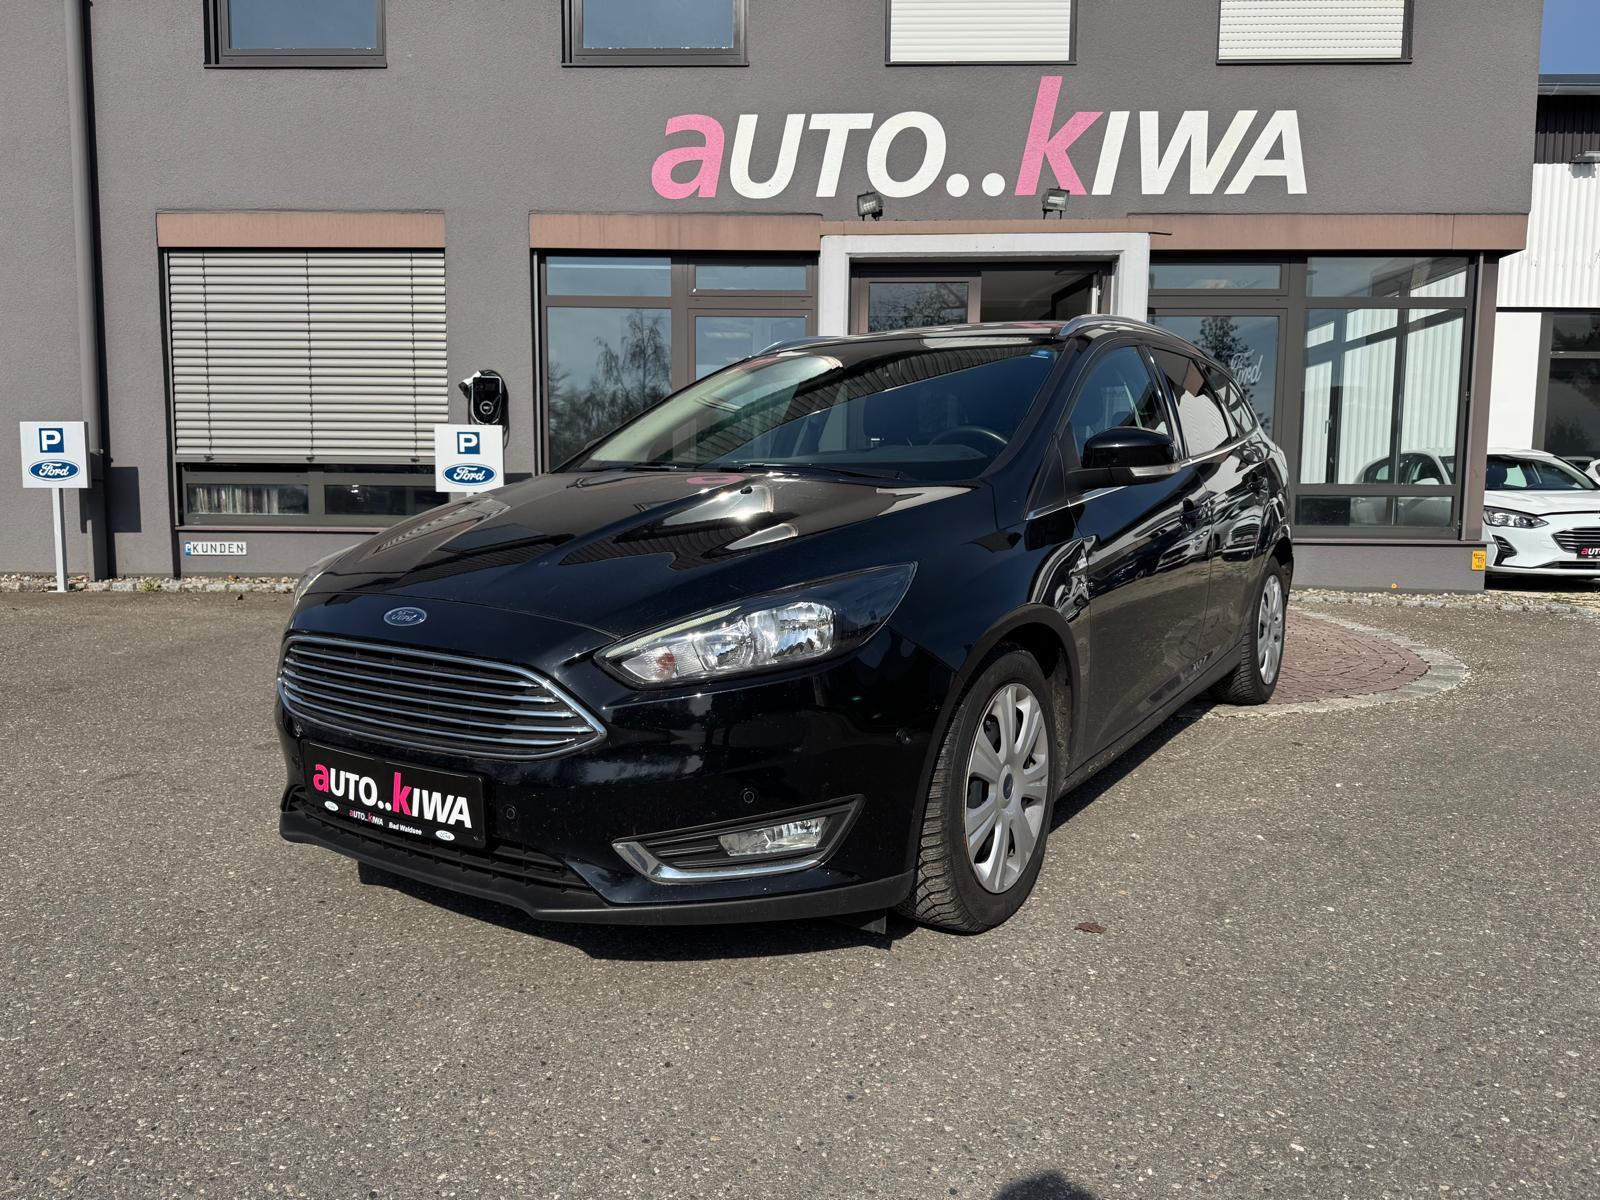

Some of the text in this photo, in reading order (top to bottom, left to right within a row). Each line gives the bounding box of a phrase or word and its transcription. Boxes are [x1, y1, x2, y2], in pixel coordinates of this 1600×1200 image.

[41, 430, 62, 451] P
[458, 433, 478, 453] P
[38, 462, 70, 477] Ford
[453, 466, 486, 481] Ford
[192, 543, 245, 554] KUNDEN
[391, 609, 418, 621] Ford
[388, 821, 400, 830] Bad
